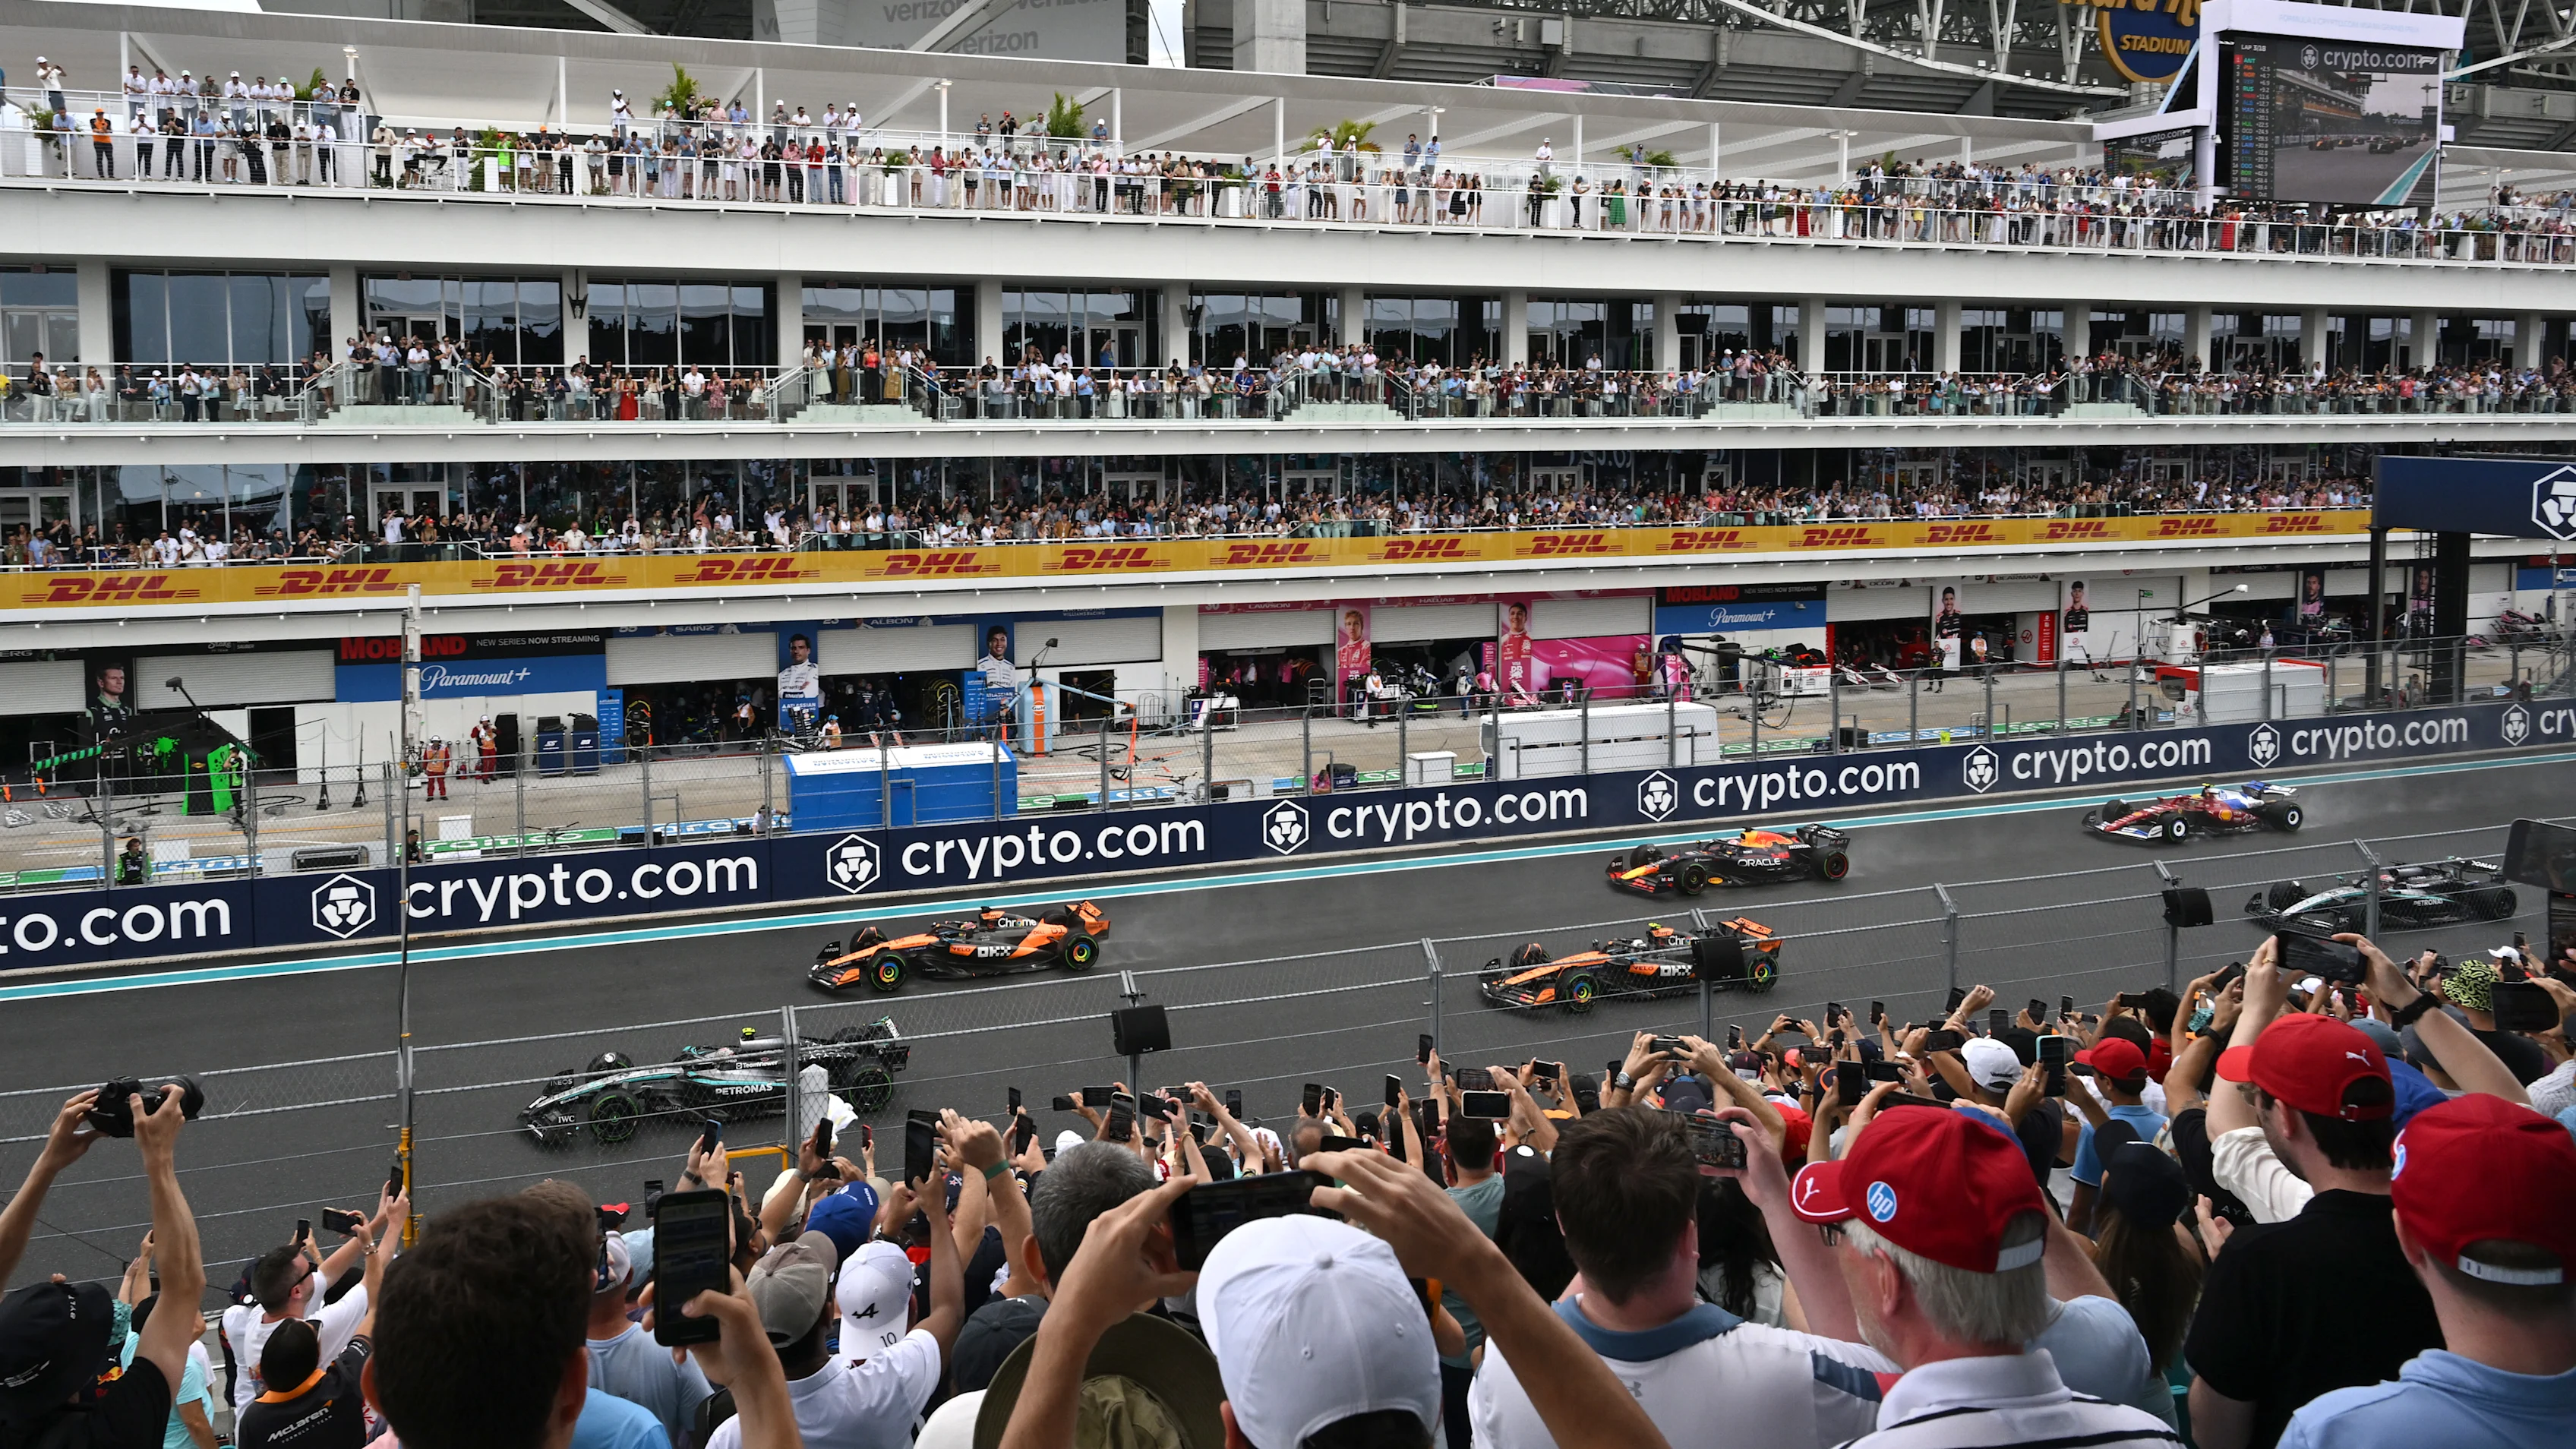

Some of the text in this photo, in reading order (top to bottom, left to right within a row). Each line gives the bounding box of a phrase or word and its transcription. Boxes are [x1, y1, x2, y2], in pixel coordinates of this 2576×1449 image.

[952, 29, 1039, 55] verizon
[2120, 34, 2192, 55] STADIUM
[2324, 49, 2423, 70] crypto.com
[2047, 522, 2111, 538] DHL
[2160, 519, 2220, 535] DHL
[2268, 516, 2323, 532] DHL
[1533, 535, 1611, 554] DHL
[1671, 532, 1745, 550] DHL
[1804, 529, 1875, 546] DHL
[1929, 526, 1995, 543] DHL
[1063, 548, 1155, 569] DHL
[1228, 544, 1317, 564] DHL
[1385, 539, 1467, 560] DHL
[696, 558, 802, 580] DHL
[886, 553, 984, 575] DHL
[279, 570, 399, 595] DHL
[494, 564, 608, 587] DHL
[46, 576, 177, 601] DHL
[1666, 586, 1739, 603] MOBLAND
[1419, 596, 1455, 605] HADJAR
[870, 617, 914, 626] ALBON
[1708, 607, 1776, 627] Paramount+
[674, 624, 715, 633] SAINZ
[341, 636, 467, 660] MOBAND
[476, 634, 600, 647] NEW SERIES NOW STREAMING
[419, 665, 531, 693] Paramount+
[2292, 718, 2468, 759] crypto.com
[2012, 737, 2211, 784] crypto.com
[1694, 760, 1920, 811] crypto.com
[1327, 787, 1587, 843] crypto.com
[901, 820, 1205, 879] crypto.com
[1738, 857, 1782, 867] ORACLE
[406, 856, 758, 922] crypto.com
[2413, 898, 2444, 906] PETRONAS
[998, 917, 1037, 928] Chrome
[977, 945, 1012, 958] OKX
[1659, 964, 1693, 977] OKX
[743, 1060, 778, 1069] TeamViewer
[550, 1078, 573, 1087] INEOS
[715, 1083, 774, 1097] PETRONAS
[558, 1115, 576, 1123] IWC
[1870, 1184, 1894, 1218] hp
[68, 1294, 76, 1320] BYLT
[880, 1331, 898, 1349] 10
[267, 1406, 330, 1442] McLaren
[282, 1426, 310, 1444] FORMULA
[316, 1414, 333, 1426] TEAM
